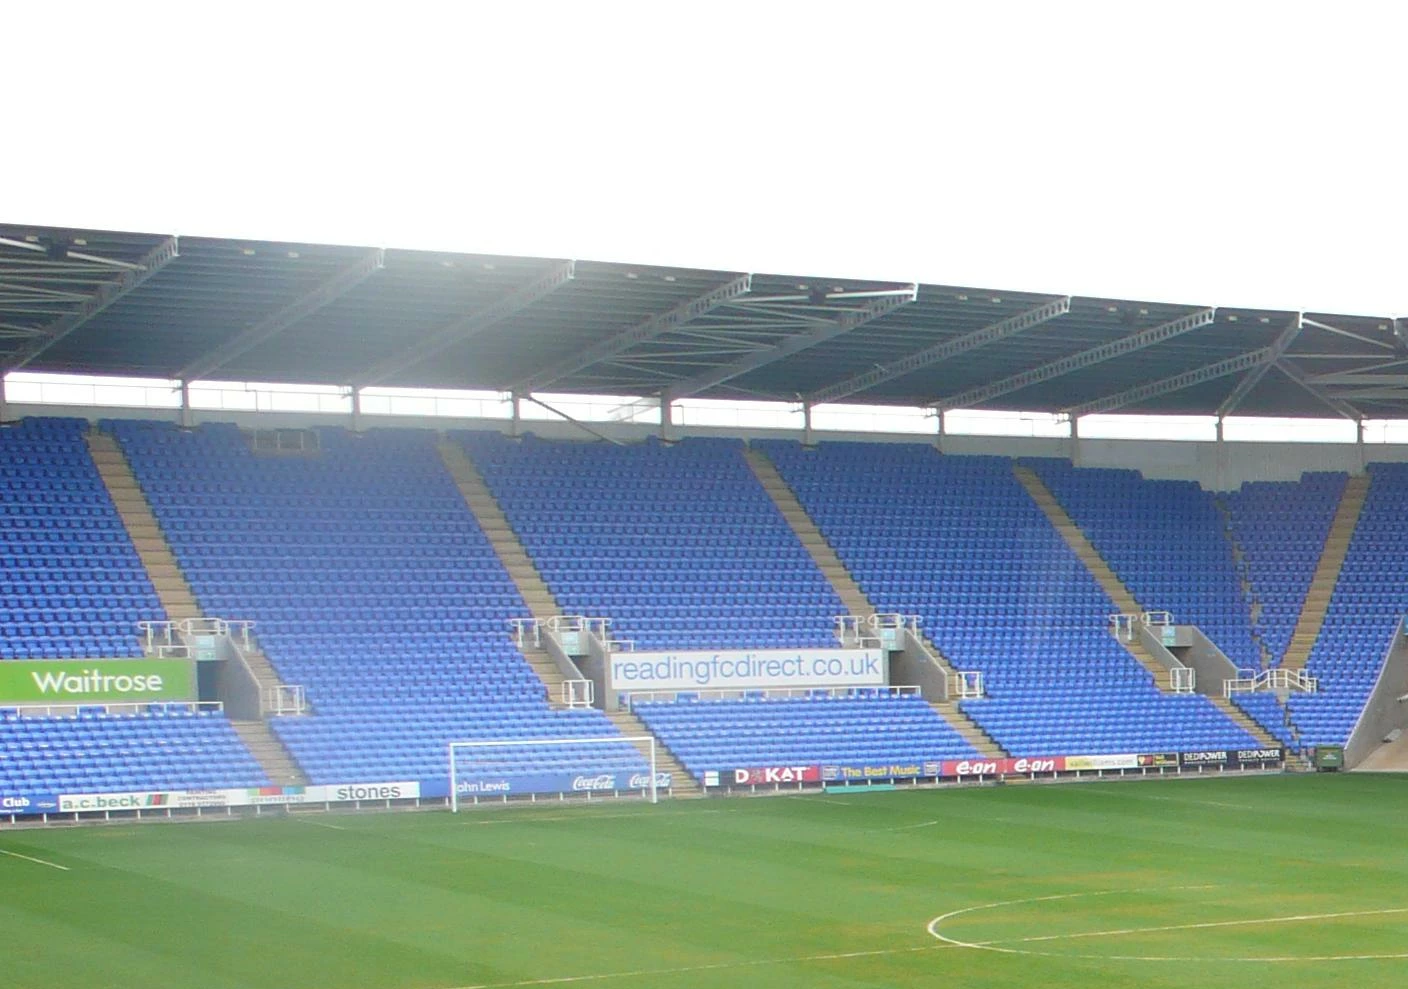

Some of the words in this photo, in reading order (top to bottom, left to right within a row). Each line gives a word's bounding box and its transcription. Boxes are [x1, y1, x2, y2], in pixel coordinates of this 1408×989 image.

[613, 653, 880, 684] readingfcdirect.co.uk
[31, 668, 163, 694] Waitrose
[840, 767, 862, 778] The
[337, 785, 401, 800] stones
[480, 780, 510, 792] Lewis
[3, 797, 30, 808] Club
[62, 796, 141, 810] a.c.beck
